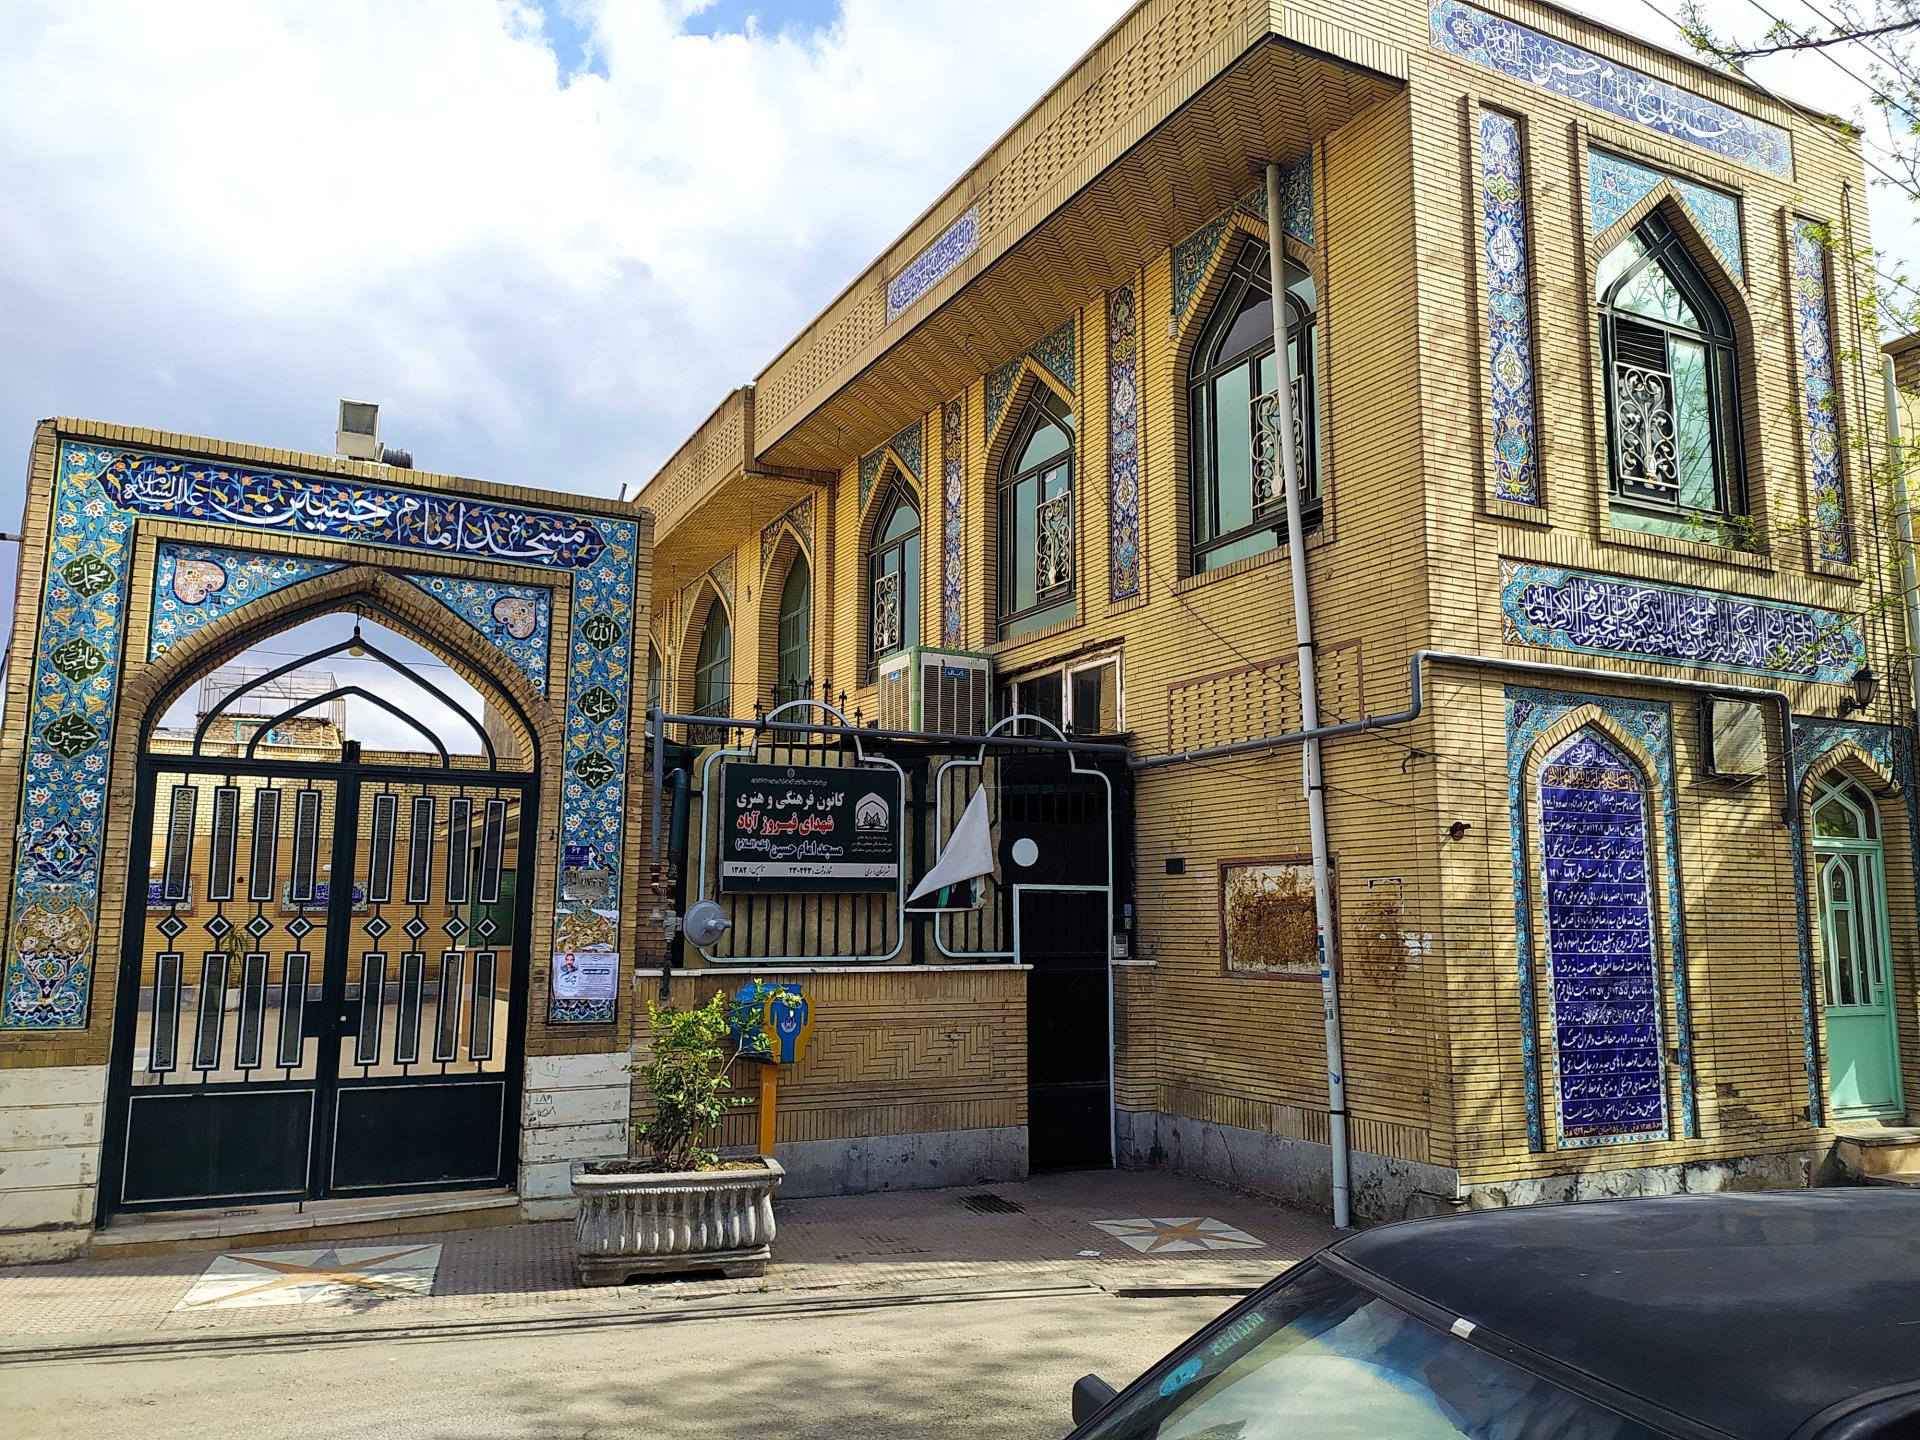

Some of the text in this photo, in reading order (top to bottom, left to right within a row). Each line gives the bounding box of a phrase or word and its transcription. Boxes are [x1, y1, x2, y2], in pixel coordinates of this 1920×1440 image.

[209, 491, 392, 532] حسین
[397, 497, 467, 551] امام
[464, 516, 586, 564] مسجد
[586, 621, 616, 642] الله
[736, 789, 845, 811] کانون فرهنگی و هنری
[736, 810, 834, 836] شهدای فیروز آباد
[769, 844, 798, 860] حسین
[796, 840, 817, 860] امام
[816, 843, 844, 860] مسجد
